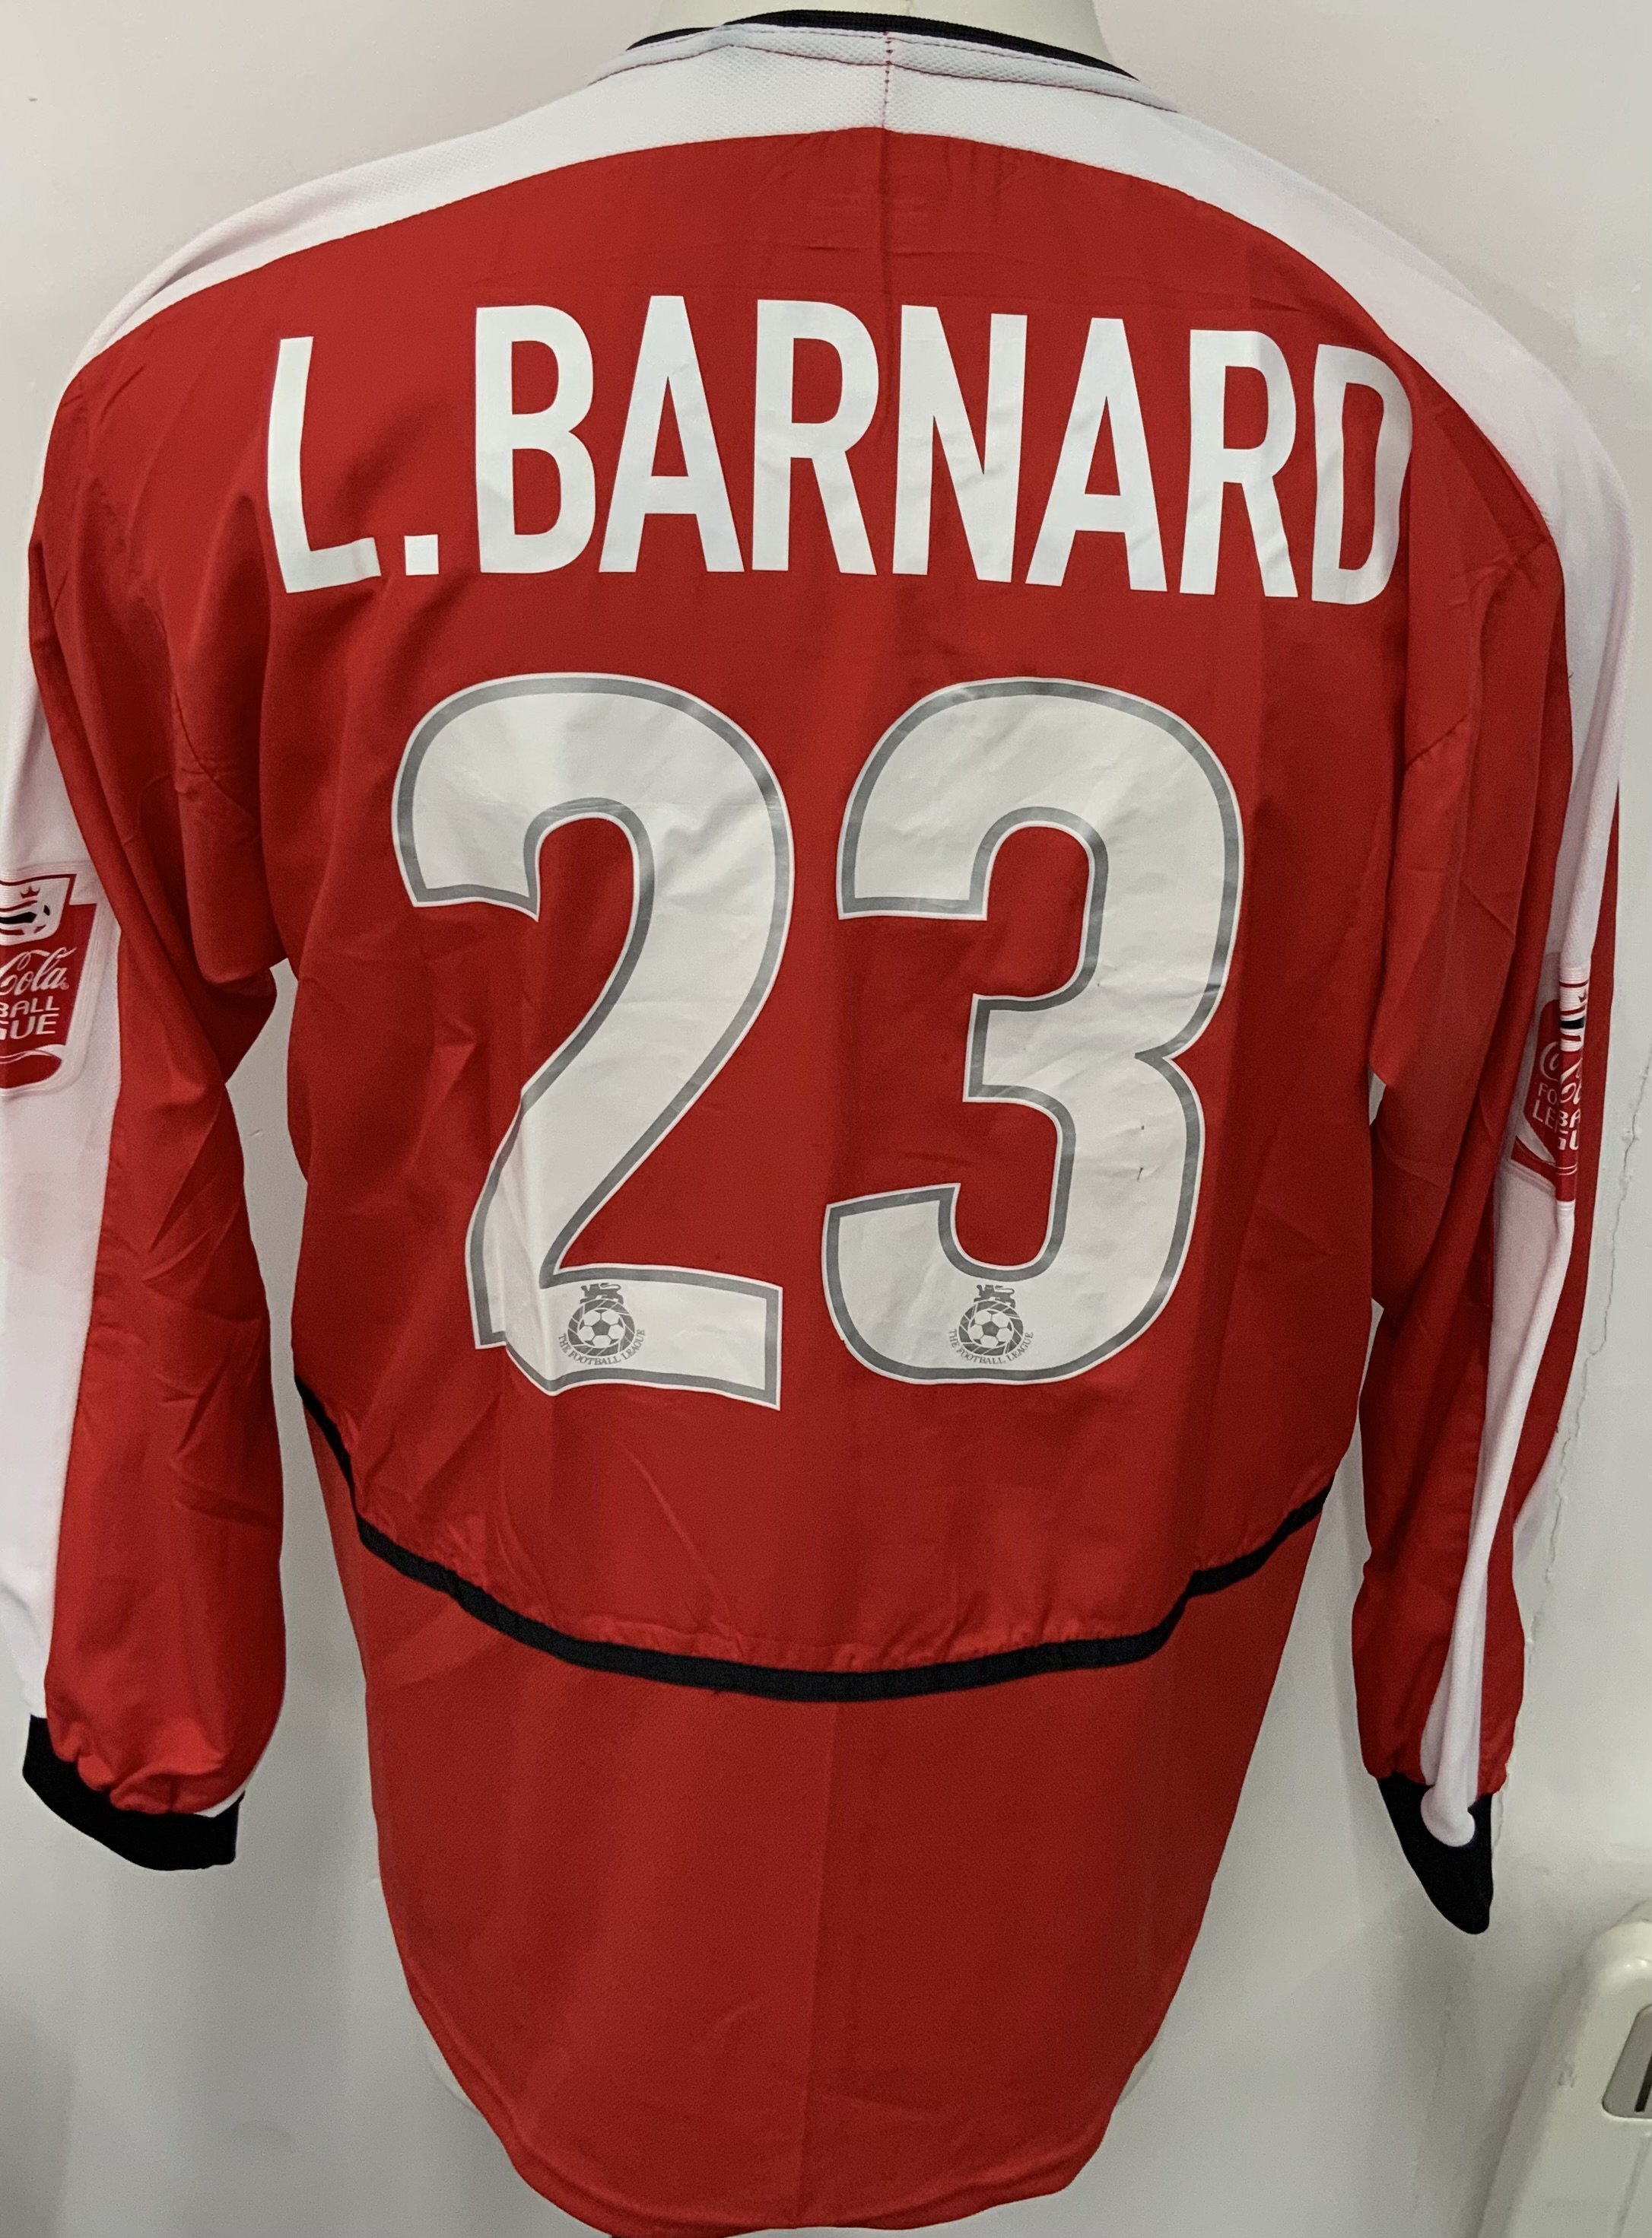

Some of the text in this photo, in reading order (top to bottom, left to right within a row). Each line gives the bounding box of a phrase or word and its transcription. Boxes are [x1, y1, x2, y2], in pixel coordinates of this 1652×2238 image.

[392, 672, 1245, 1411] 23
[558, 1329, 646, 1365] THE FOOTBALL LEAGUE
[948, 1328, 1034, 1365] THE FOOTBALL LEAGUE
